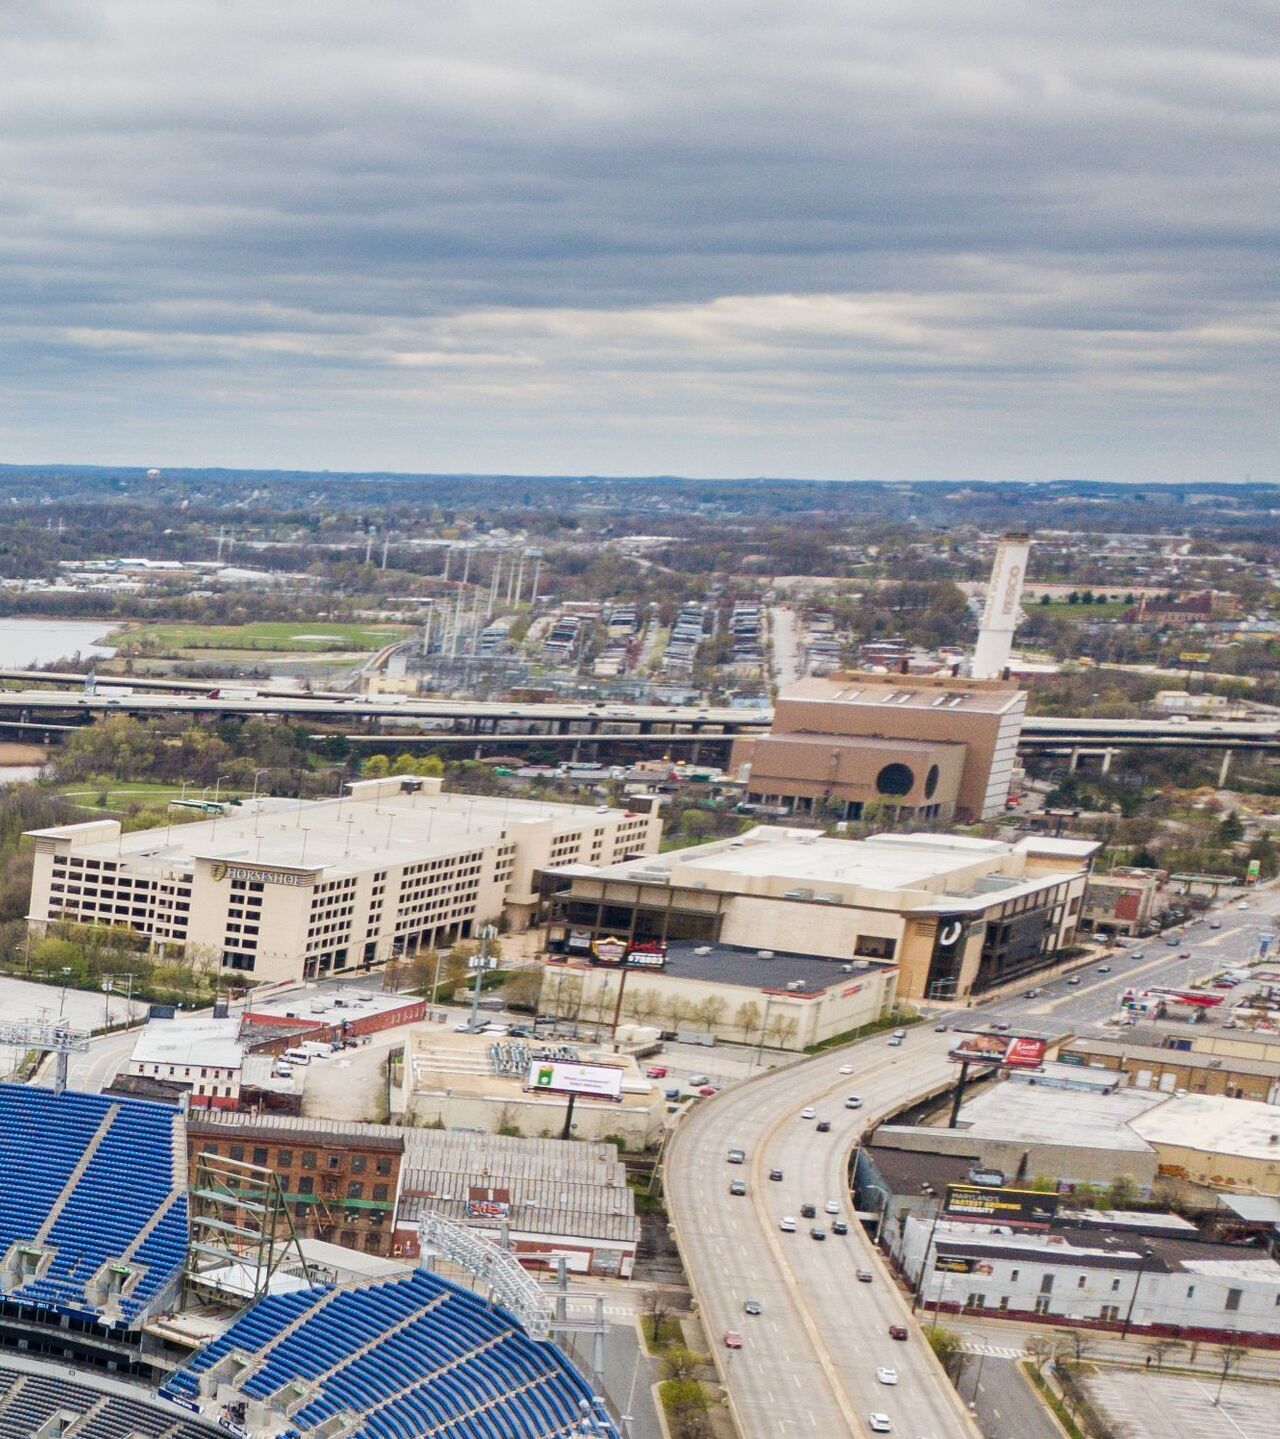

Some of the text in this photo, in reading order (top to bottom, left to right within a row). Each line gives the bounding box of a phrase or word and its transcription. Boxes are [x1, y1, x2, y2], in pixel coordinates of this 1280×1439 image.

[226, 867, 302, 886] HORSESHOE
[951, 1193, 1000, 1202] MARYLAND'S
[948, 1204, 994, 1214] UNIVERSITY
[950, 1198, 1022, 1210] FASTEST GROWING
